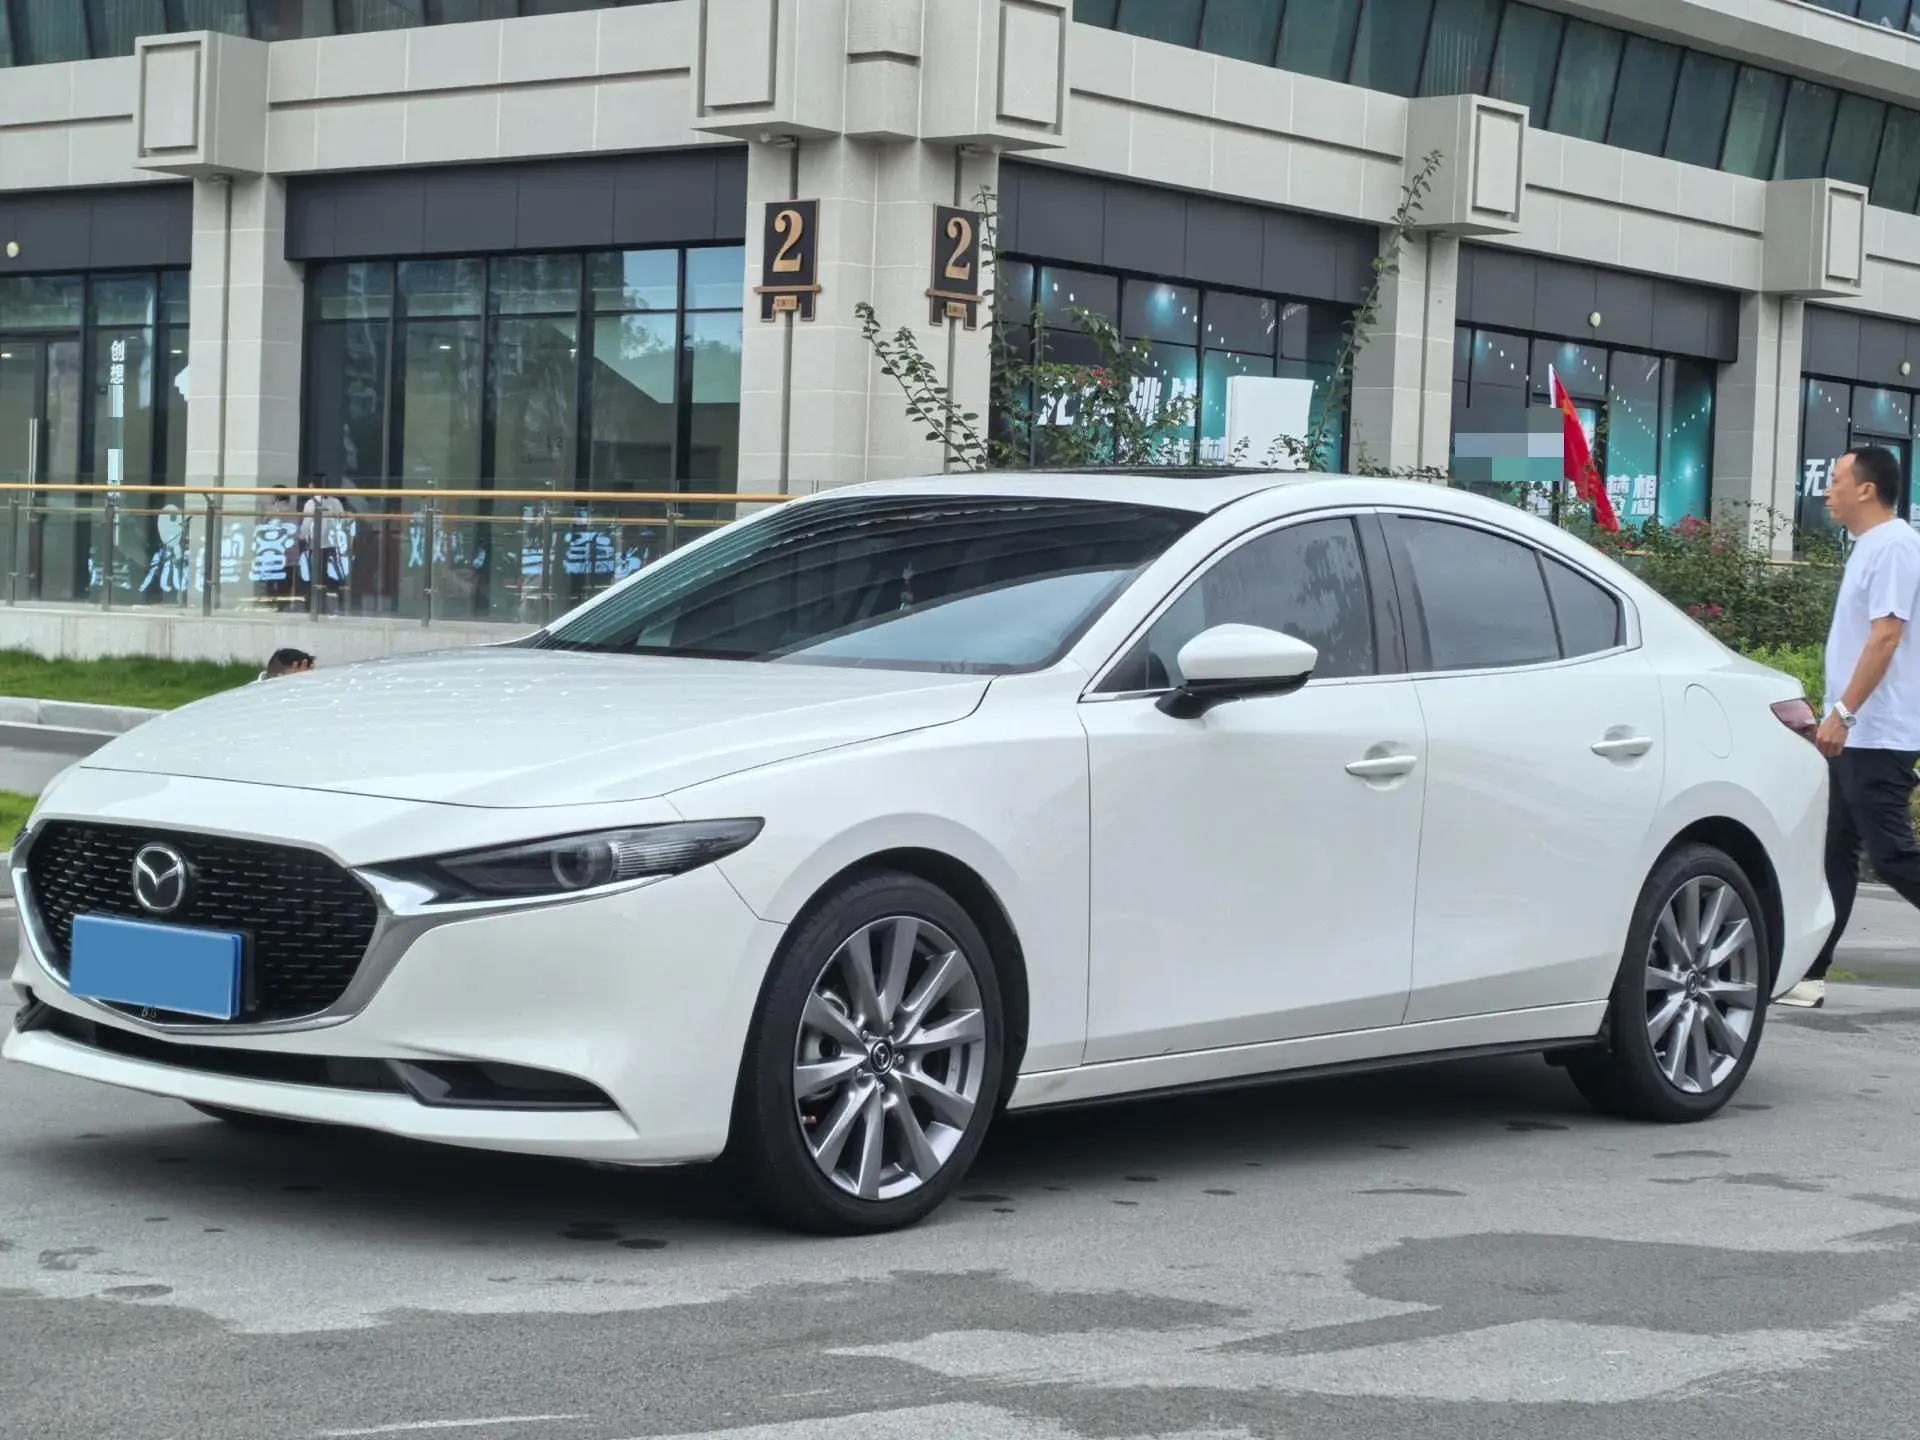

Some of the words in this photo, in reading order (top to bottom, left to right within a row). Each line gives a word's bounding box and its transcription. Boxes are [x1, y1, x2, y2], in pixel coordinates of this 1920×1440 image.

[772, 210, 803, 272] 2
[944, 217, 972, 281] 2
[1805, 457, 1833, 497] 无
